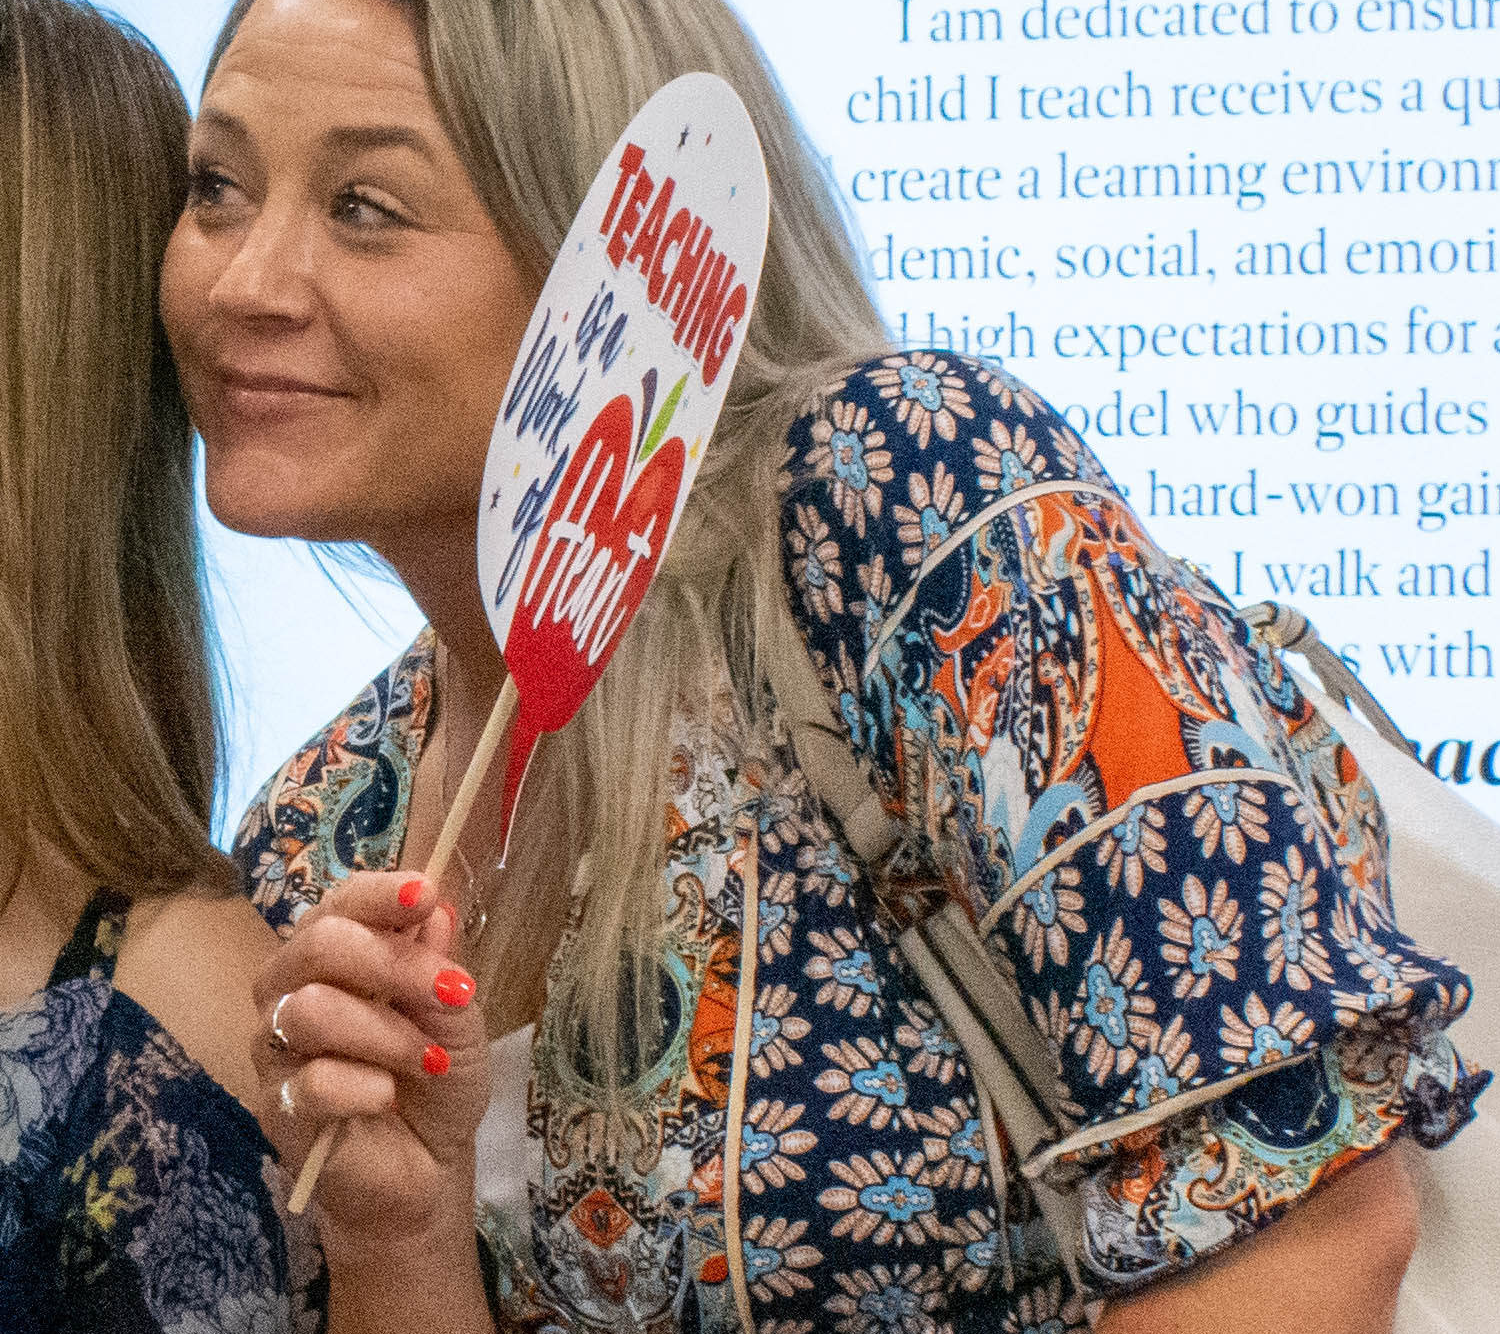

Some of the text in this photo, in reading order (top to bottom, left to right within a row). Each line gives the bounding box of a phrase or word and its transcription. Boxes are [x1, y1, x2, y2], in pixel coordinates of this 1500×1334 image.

[928, 7, 1003, 43] am
[845, 72, 968, 125] child
[986, 73, 1000, 121] I
[1017, 68, 1153, 121] teach
[1169, 68, 1383, 118] receives
[1399, 77, 1425, 114] a
[850, 164, 1003, 202] create
[1016, 165, 1041, 200] a
[1056, 149, 1268, 212] learning
[599, 142, 749, 389] TEACHING
[869, 232, 1037, 287] demic,
[1054, 227, 1216, 284] social,
[1233, 225, 1328, 276] and
[927, 311, 1037, 366] high
[1052, 309, 1389, 373] expectations
[1404, 303, 1478, 355] for
[503, 306, 587, 460] Work
[1062, 388, 1169, 437] odel
[1185, 386, 1299, 436] who
[1313, 385, 1489, 452] guides
[1146, 467, 1400, 518] hard-won
[523, 435, 657, 668] Heart
[1232, 550, 1246, 597] I
[1262, 547, 1381, 598] walk
[1396, 546, 1492, 598] and
[1378, 627, 1495, 679] with
